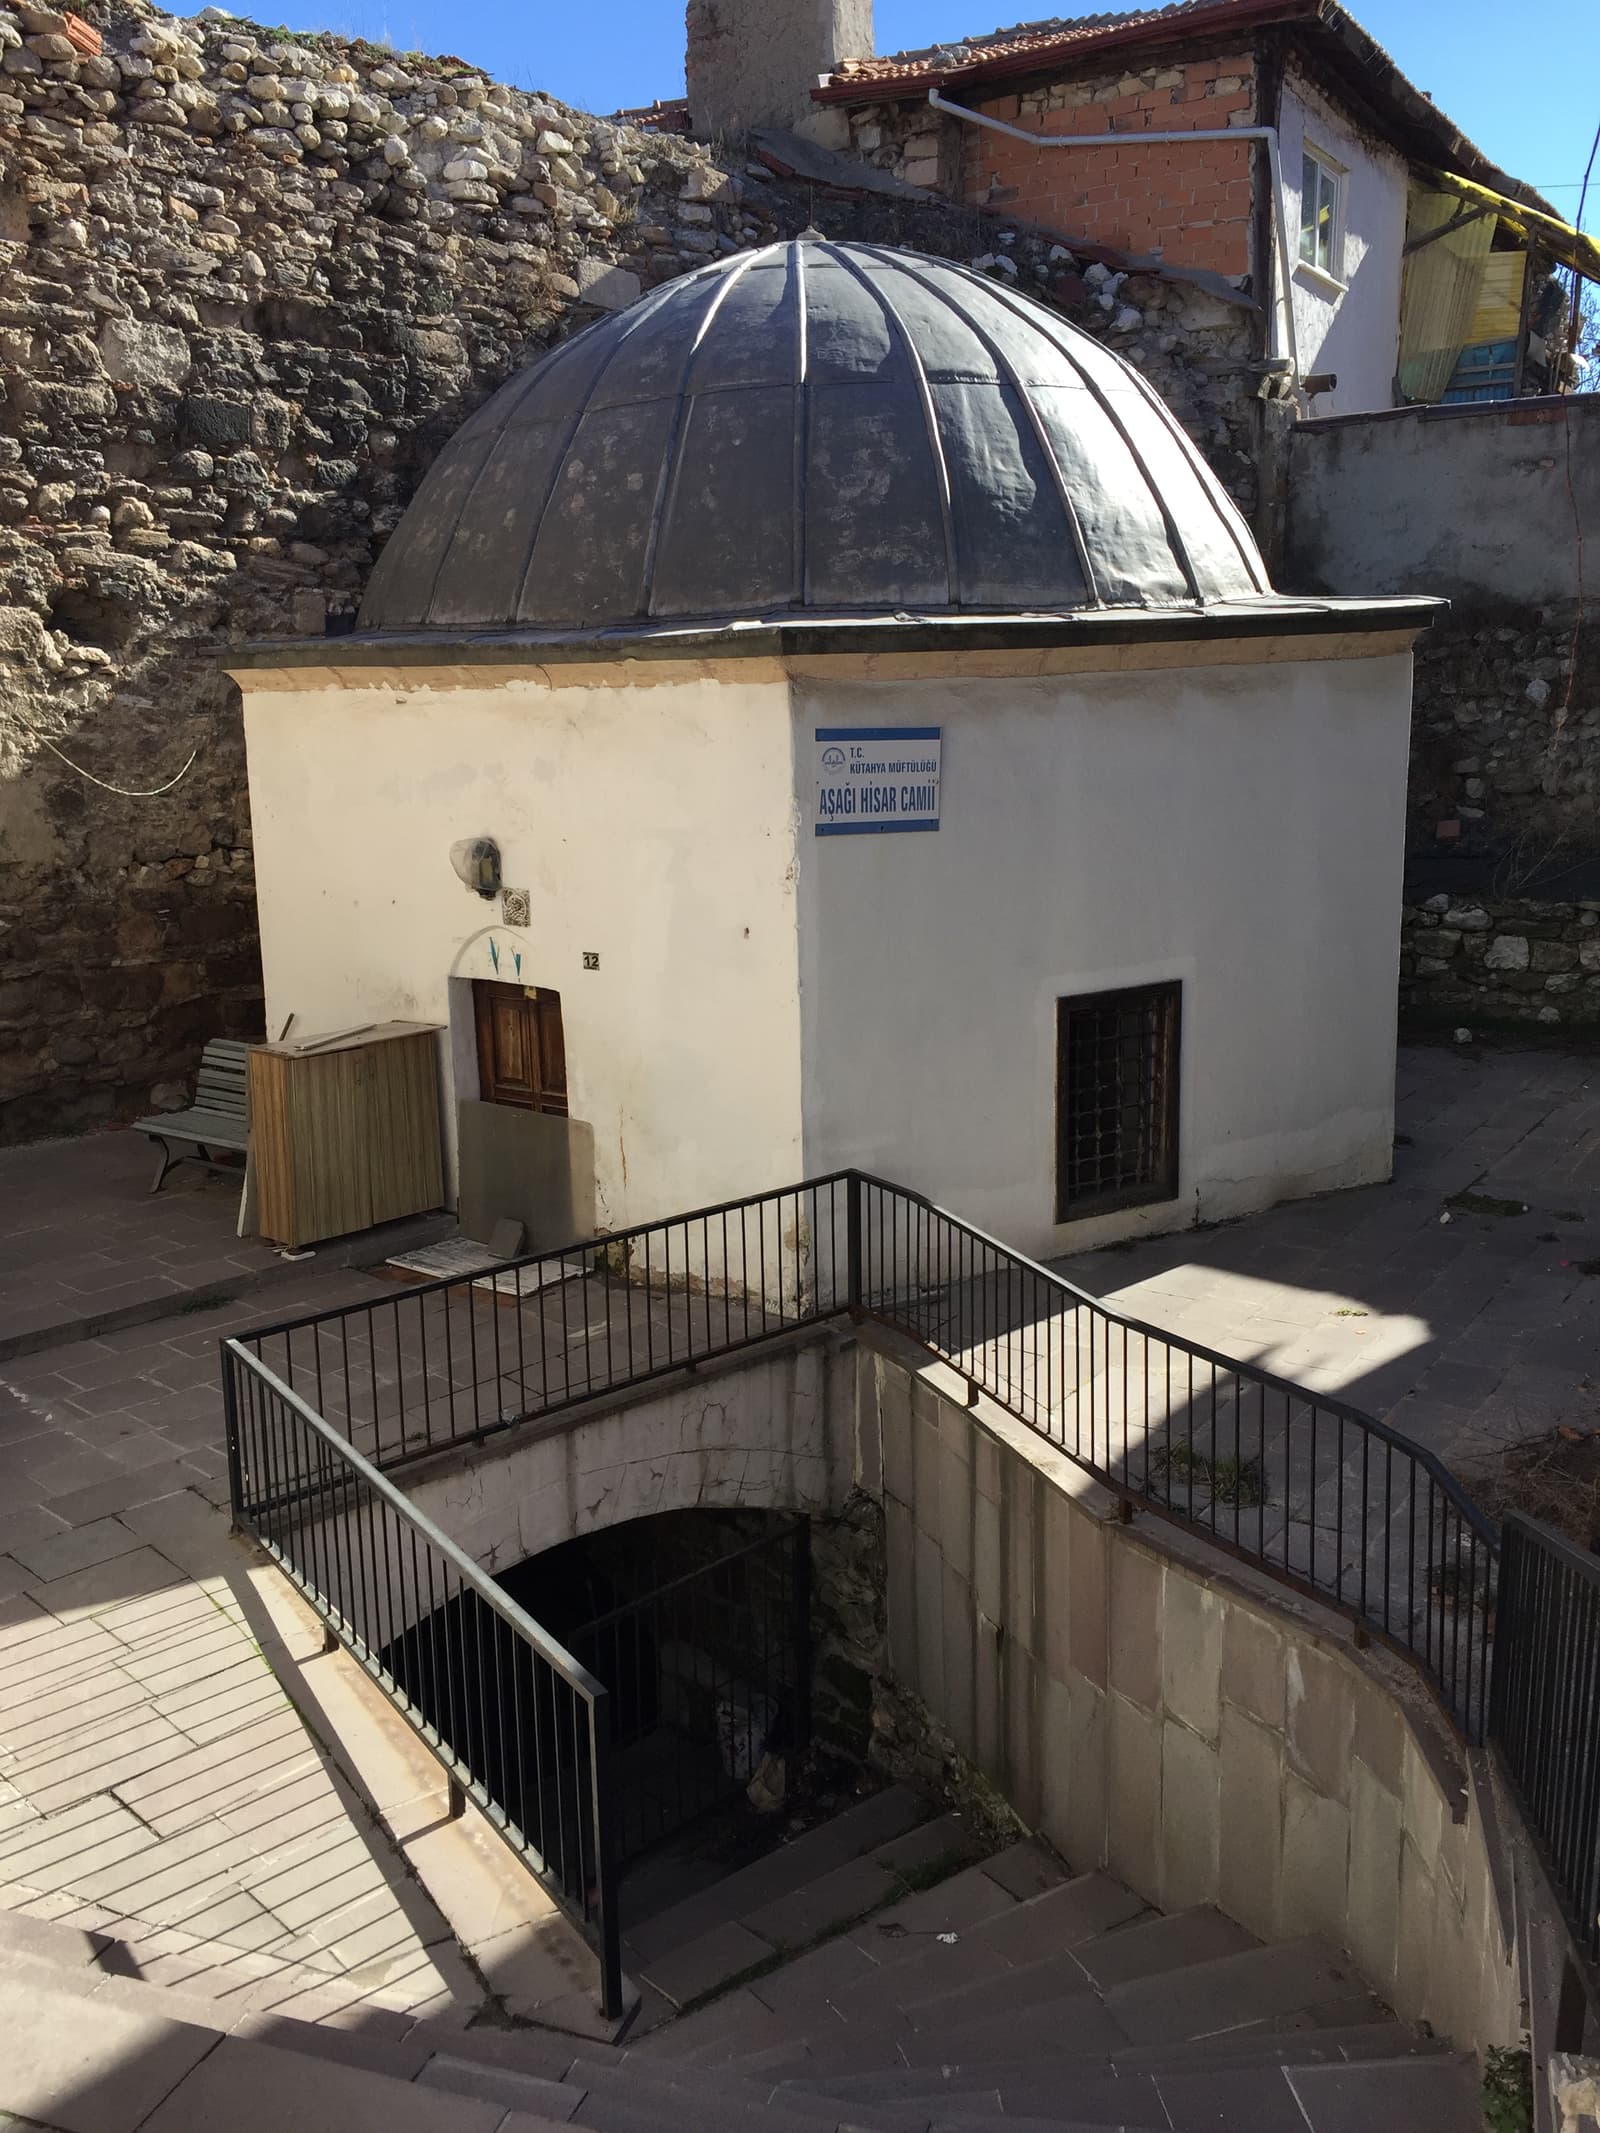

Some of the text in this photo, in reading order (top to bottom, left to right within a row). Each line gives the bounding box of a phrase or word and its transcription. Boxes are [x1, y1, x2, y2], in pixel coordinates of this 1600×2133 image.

[850, 747, 864, 758] T.C.
[850, 760, 886, 774] KÜTAHYA
[888, 759, 937, 773] MÜFTÜLÜĞÜ
[820, 779, 936, 821] AŞAĞI HİSAR CAMİİ
[584, 955, 599, 967] 12
